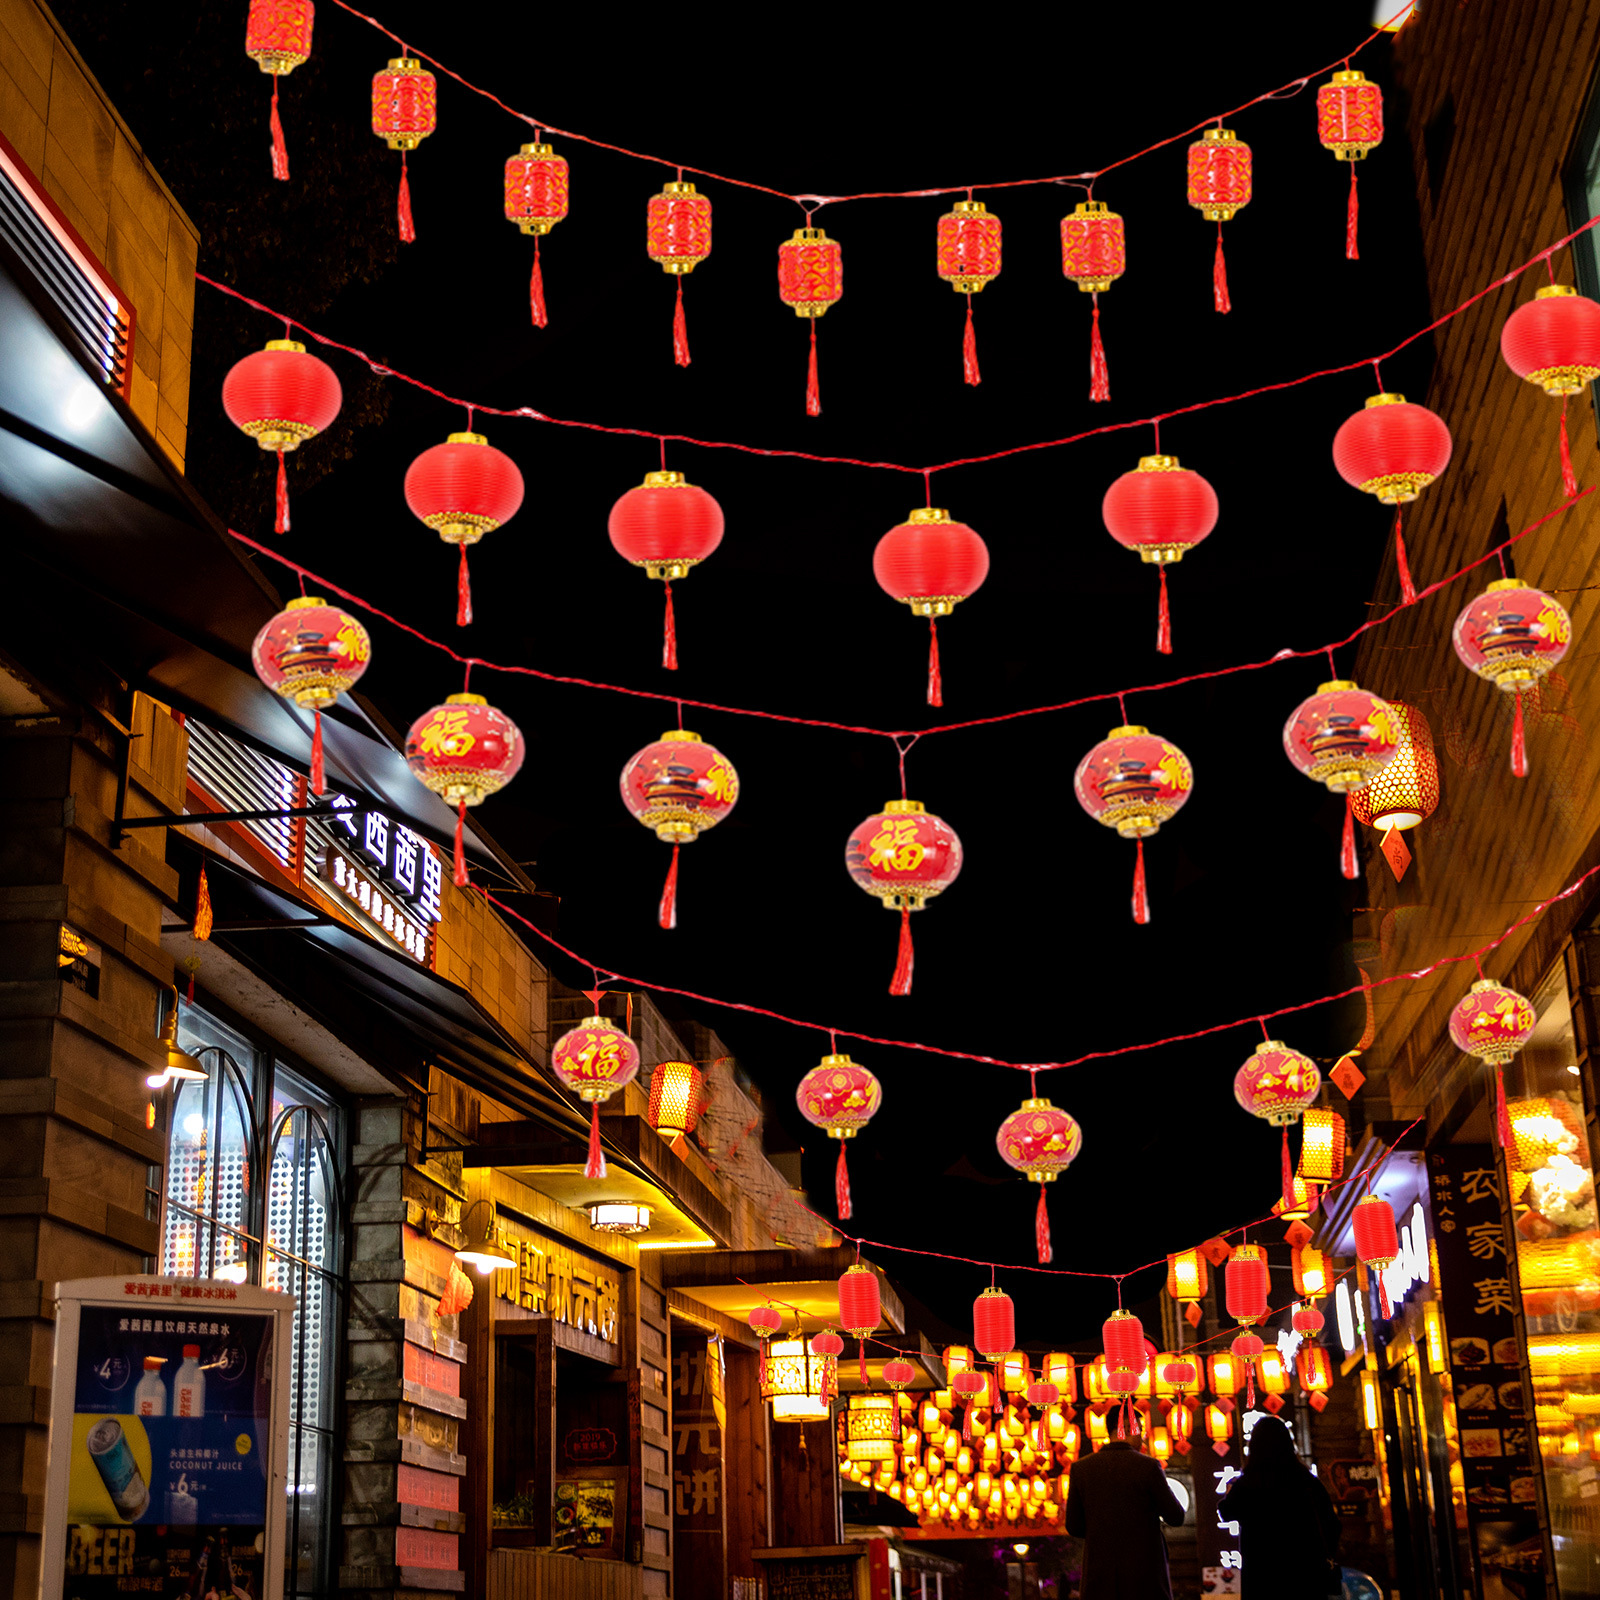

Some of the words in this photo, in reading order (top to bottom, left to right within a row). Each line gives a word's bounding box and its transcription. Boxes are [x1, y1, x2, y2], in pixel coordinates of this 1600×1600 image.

[420, 710, 475, 756] 福
[869, 819, 925, 872] 福
[578, 1032, 621, 1079] 福
[1460, 1167, 1514, 1316] 农家菜
[180, 1285, 237, 1300] 健康冰淇淋
[169, 1460, 213, 1470] COCONUT
[216, 1461, 243, 1471] JUICE
[69, 1528, 136, 1575] BEER
